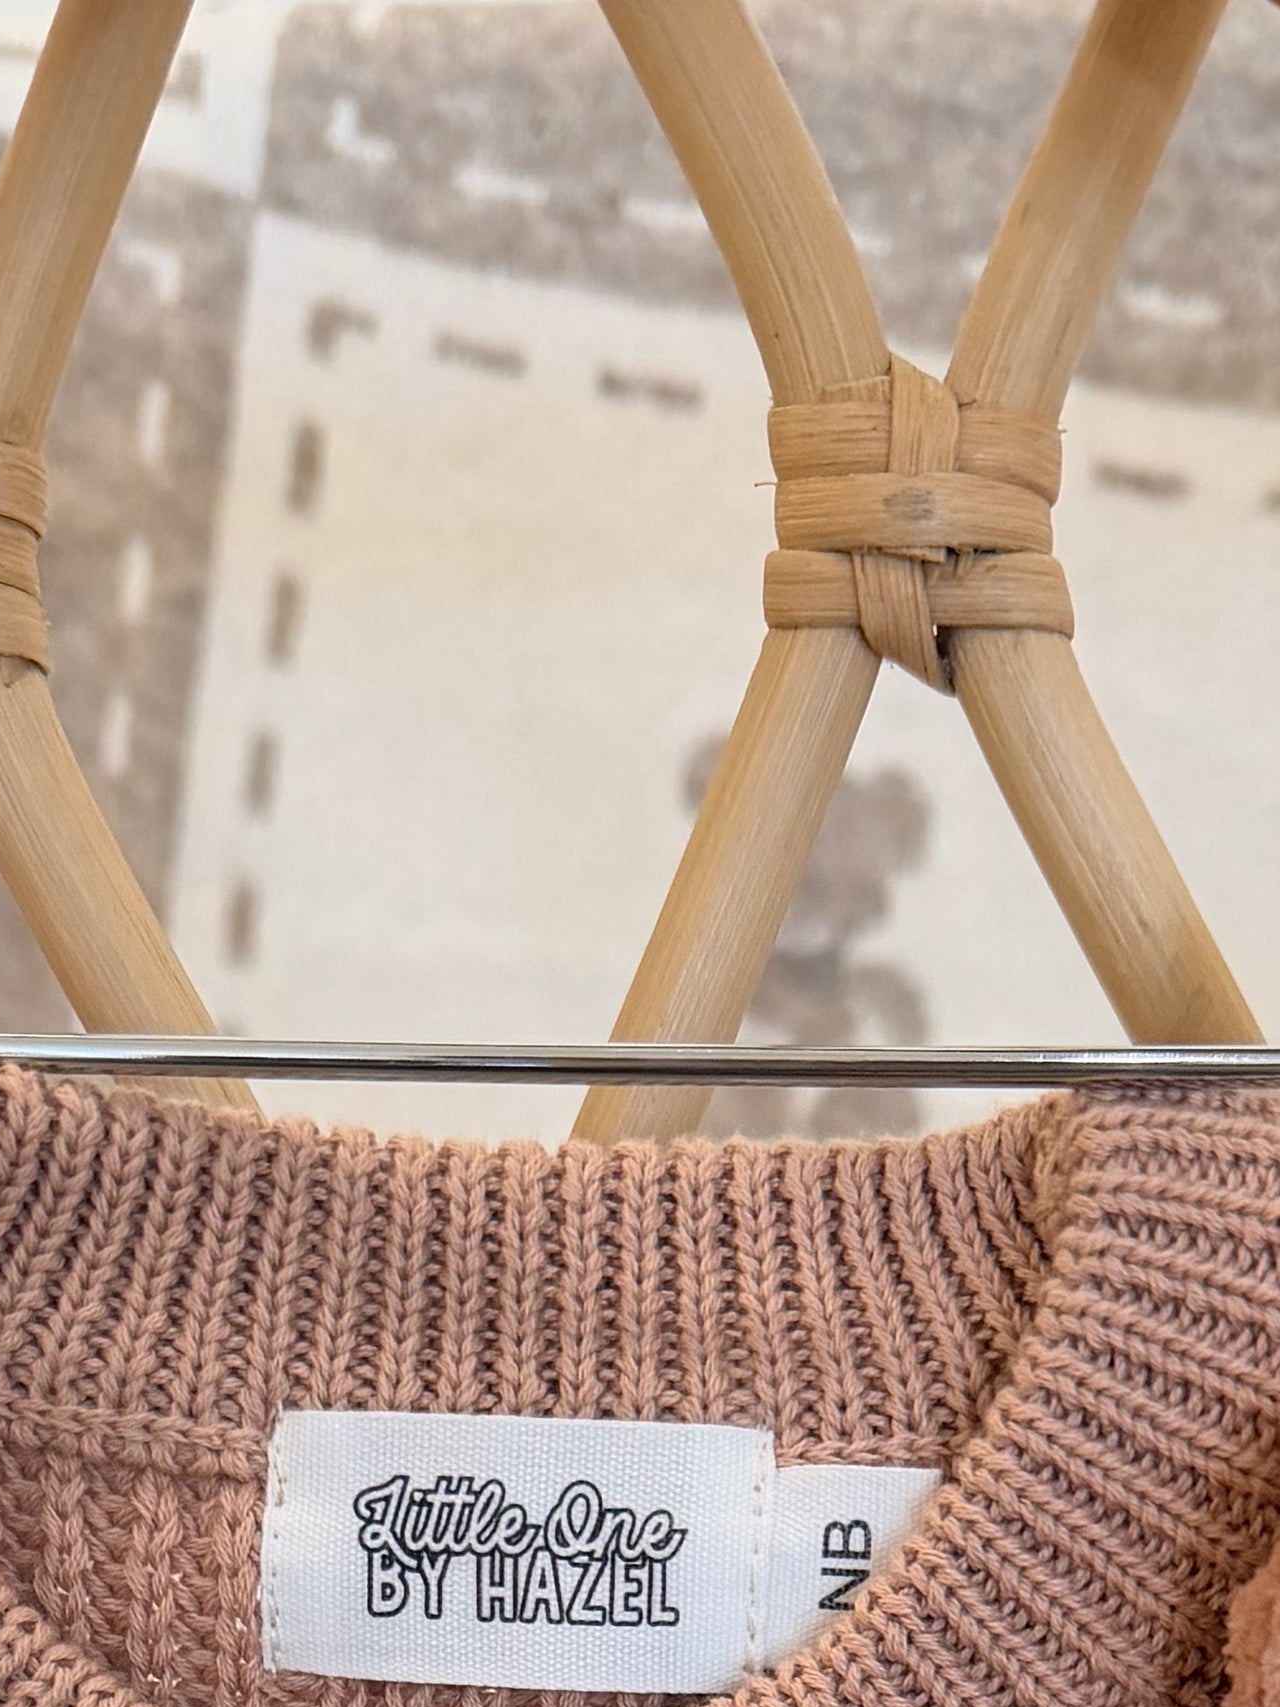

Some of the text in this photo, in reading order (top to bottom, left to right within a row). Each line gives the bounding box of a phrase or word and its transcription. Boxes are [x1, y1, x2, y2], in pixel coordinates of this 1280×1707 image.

[354, 1474, 687, 1570] Little One
[818, 1519, 872, 1610] NB
[366, 1548, 681, 1627] BY HAZEL
